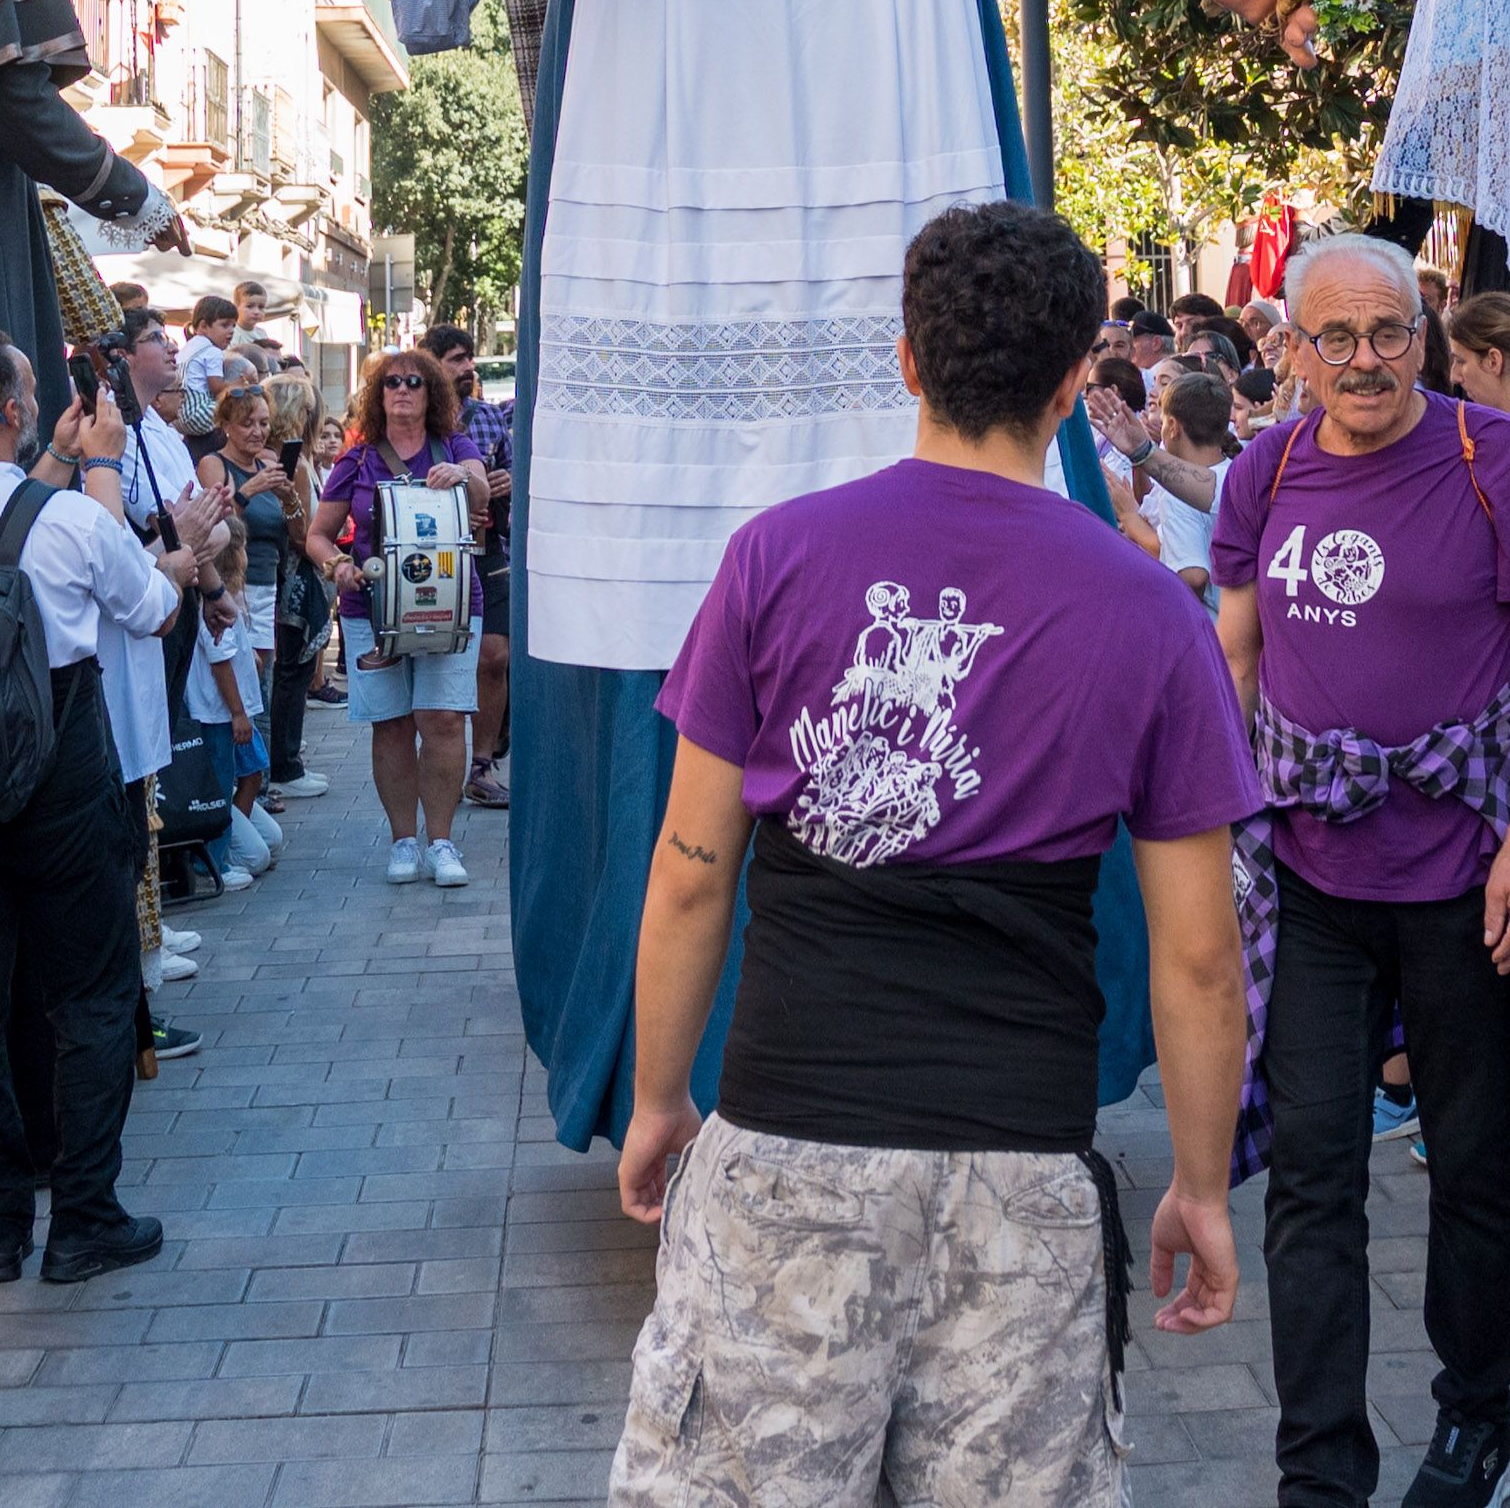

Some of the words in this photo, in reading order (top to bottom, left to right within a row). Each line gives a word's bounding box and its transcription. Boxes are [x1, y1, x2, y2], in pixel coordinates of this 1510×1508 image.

[1286, 602, 1357, 628] ANYS
[789, 677, 899, 773] Manelic
[896, 703, 917, 746] i
